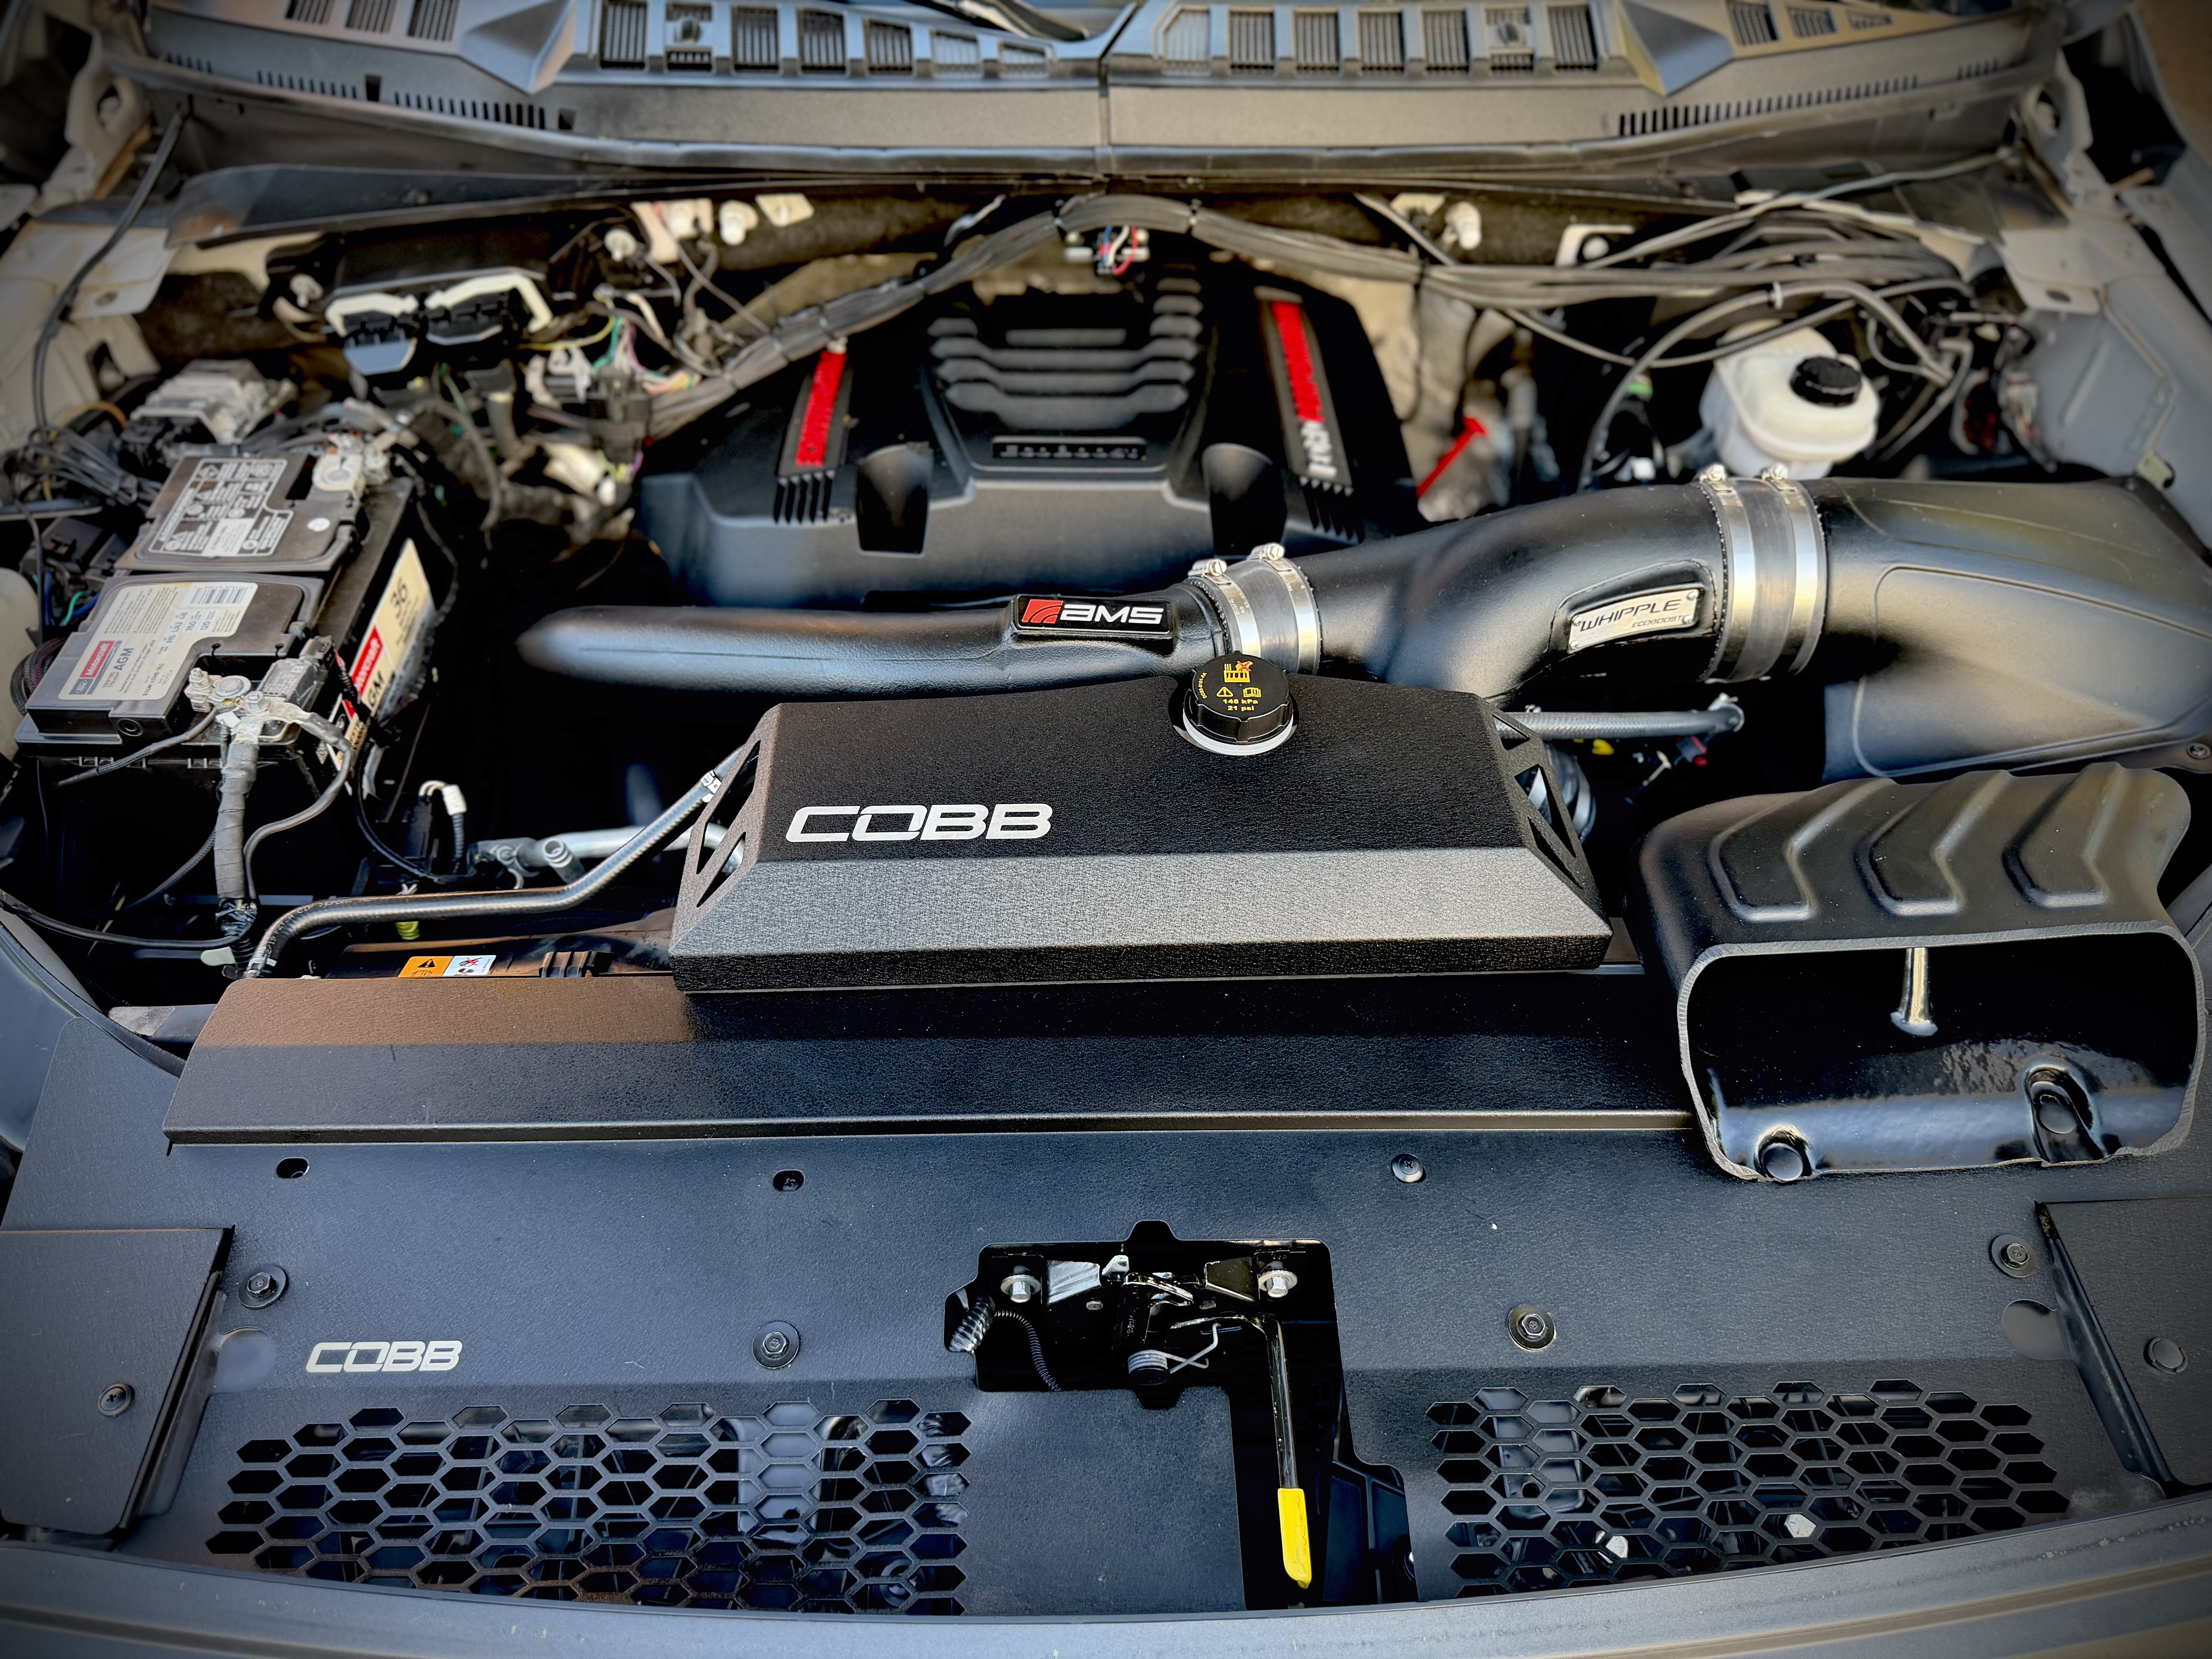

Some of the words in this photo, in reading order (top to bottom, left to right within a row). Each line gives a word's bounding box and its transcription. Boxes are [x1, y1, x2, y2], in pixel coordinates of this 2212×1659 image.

[390, 578, 409, 619] 36
[185, 621, 197, 631] 760
[200, 621, 211, 630] 120
[1060, 604, 1164, 625] AMS
[1580, 599, 1682, 632] WHIPPLE
[1631, 615, 1683, 629] ECOBOOST
[85, 642, 110, 676] Motorcraft
[113, 648, 134, 671] AGM
[102, 672, 115, 688] TESTED
[368, 671, 384, 706] GM
[785, 803, 1053, 842] COBB
[306, 1340, 463, 1372] COBB
